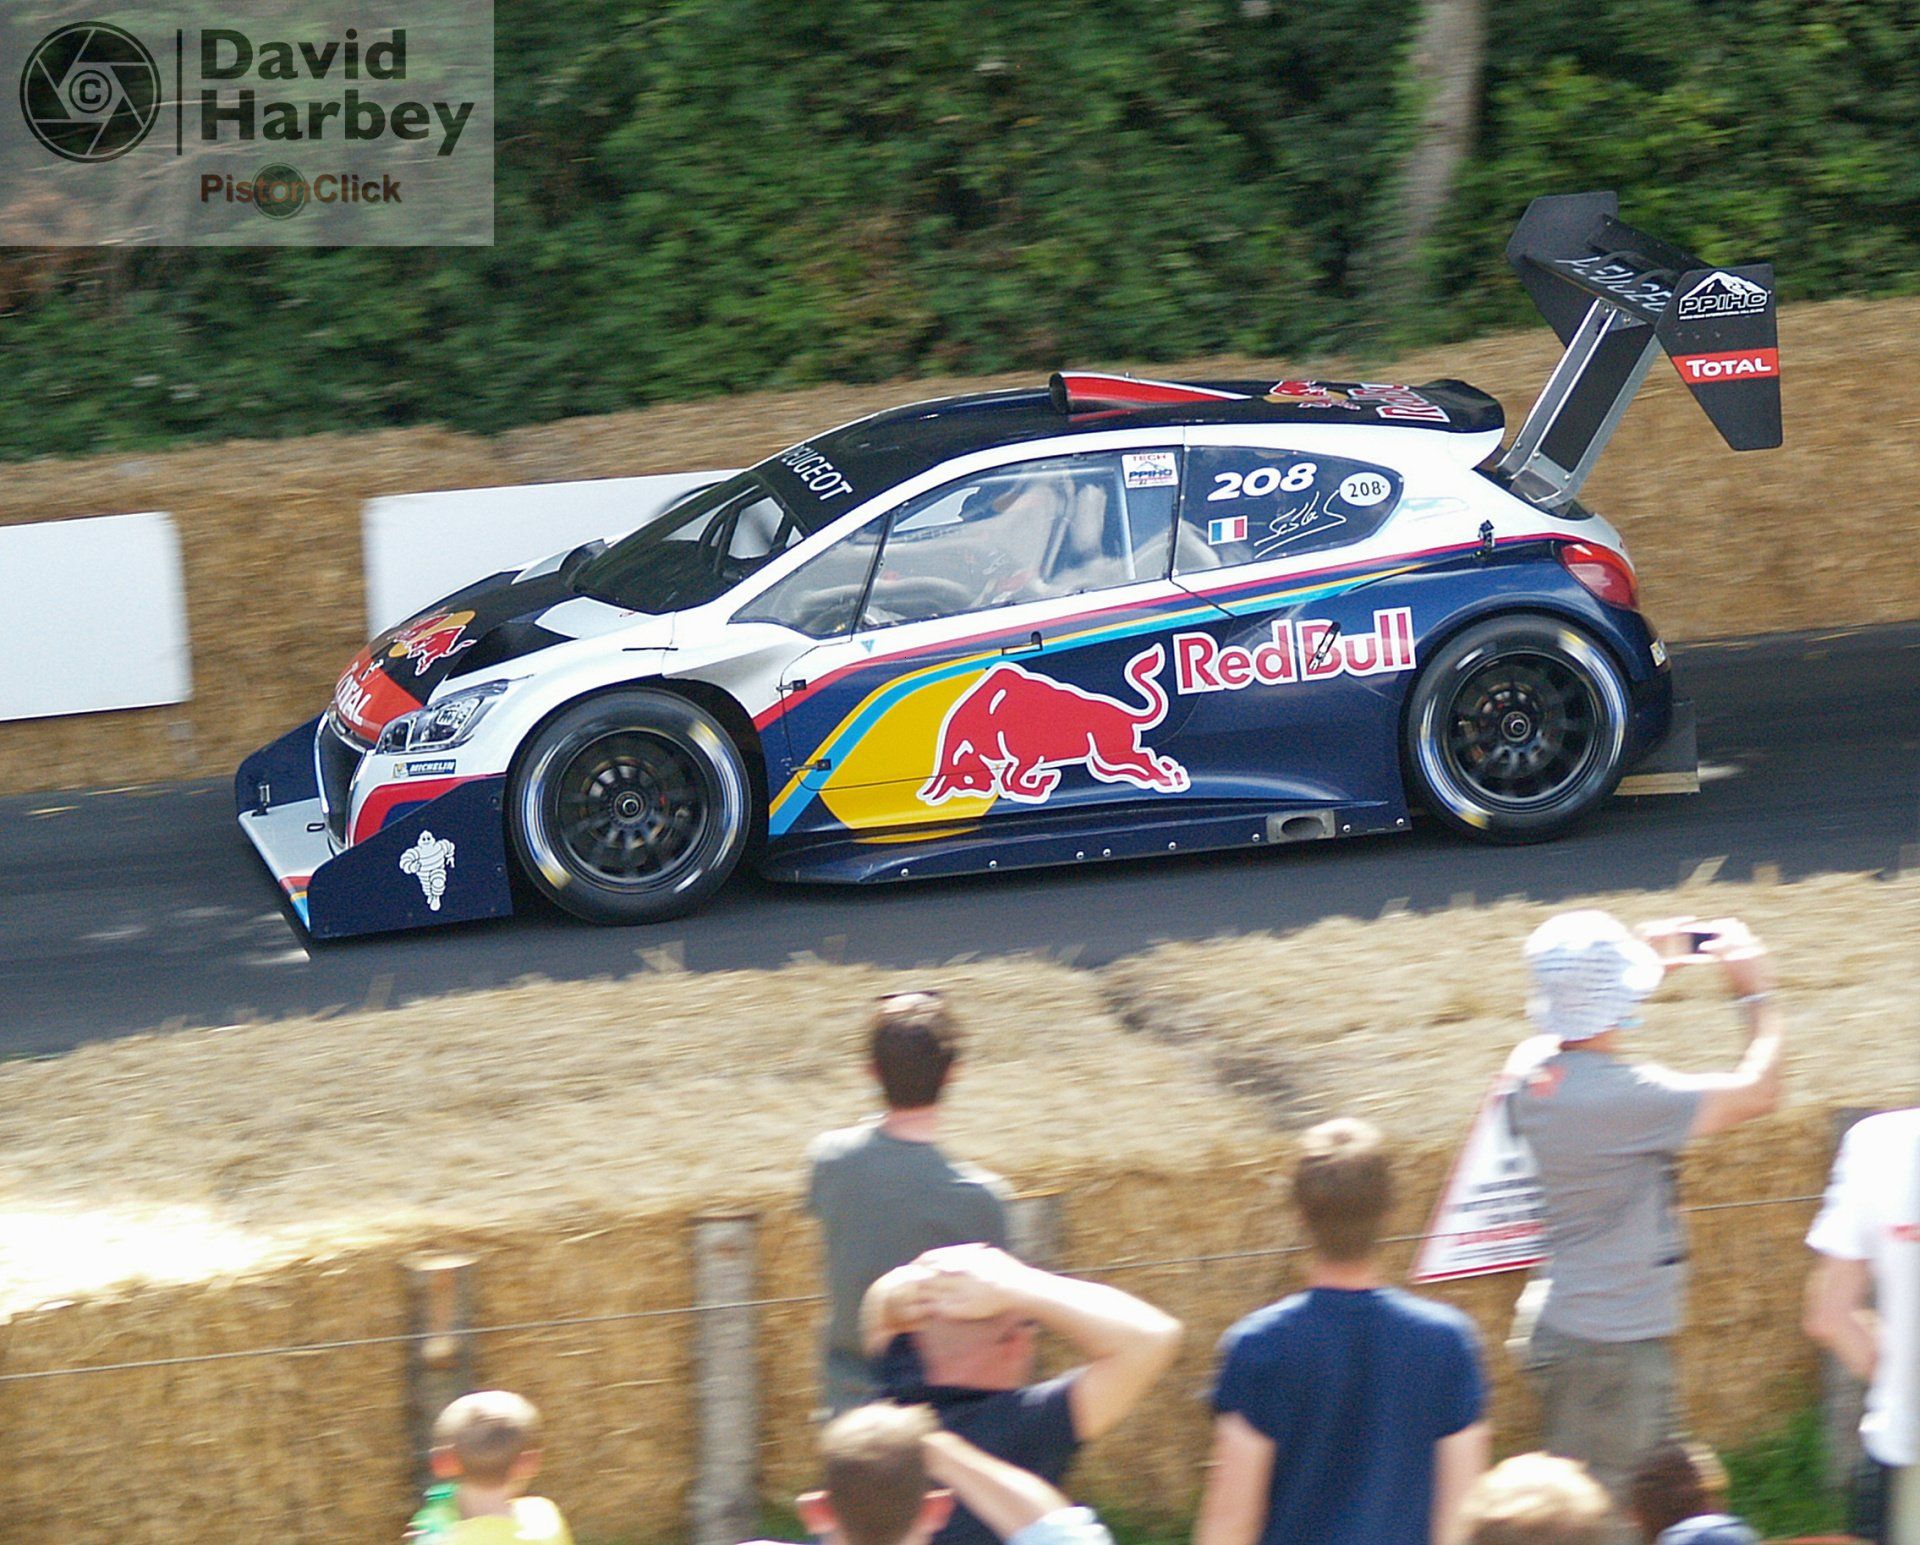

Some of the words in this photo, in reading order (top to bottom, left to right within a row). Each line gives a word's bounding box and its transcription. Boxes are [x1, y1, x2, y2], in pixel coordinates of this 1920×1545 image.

[1207, 462, 1318, 502] 208
[1349, 480, 1383, 498] 208
[1174, 620, 1297, 694] Red
[1296, 607, 1416, 681] Bull
[409, 761, 455, 773] MICHELIN
